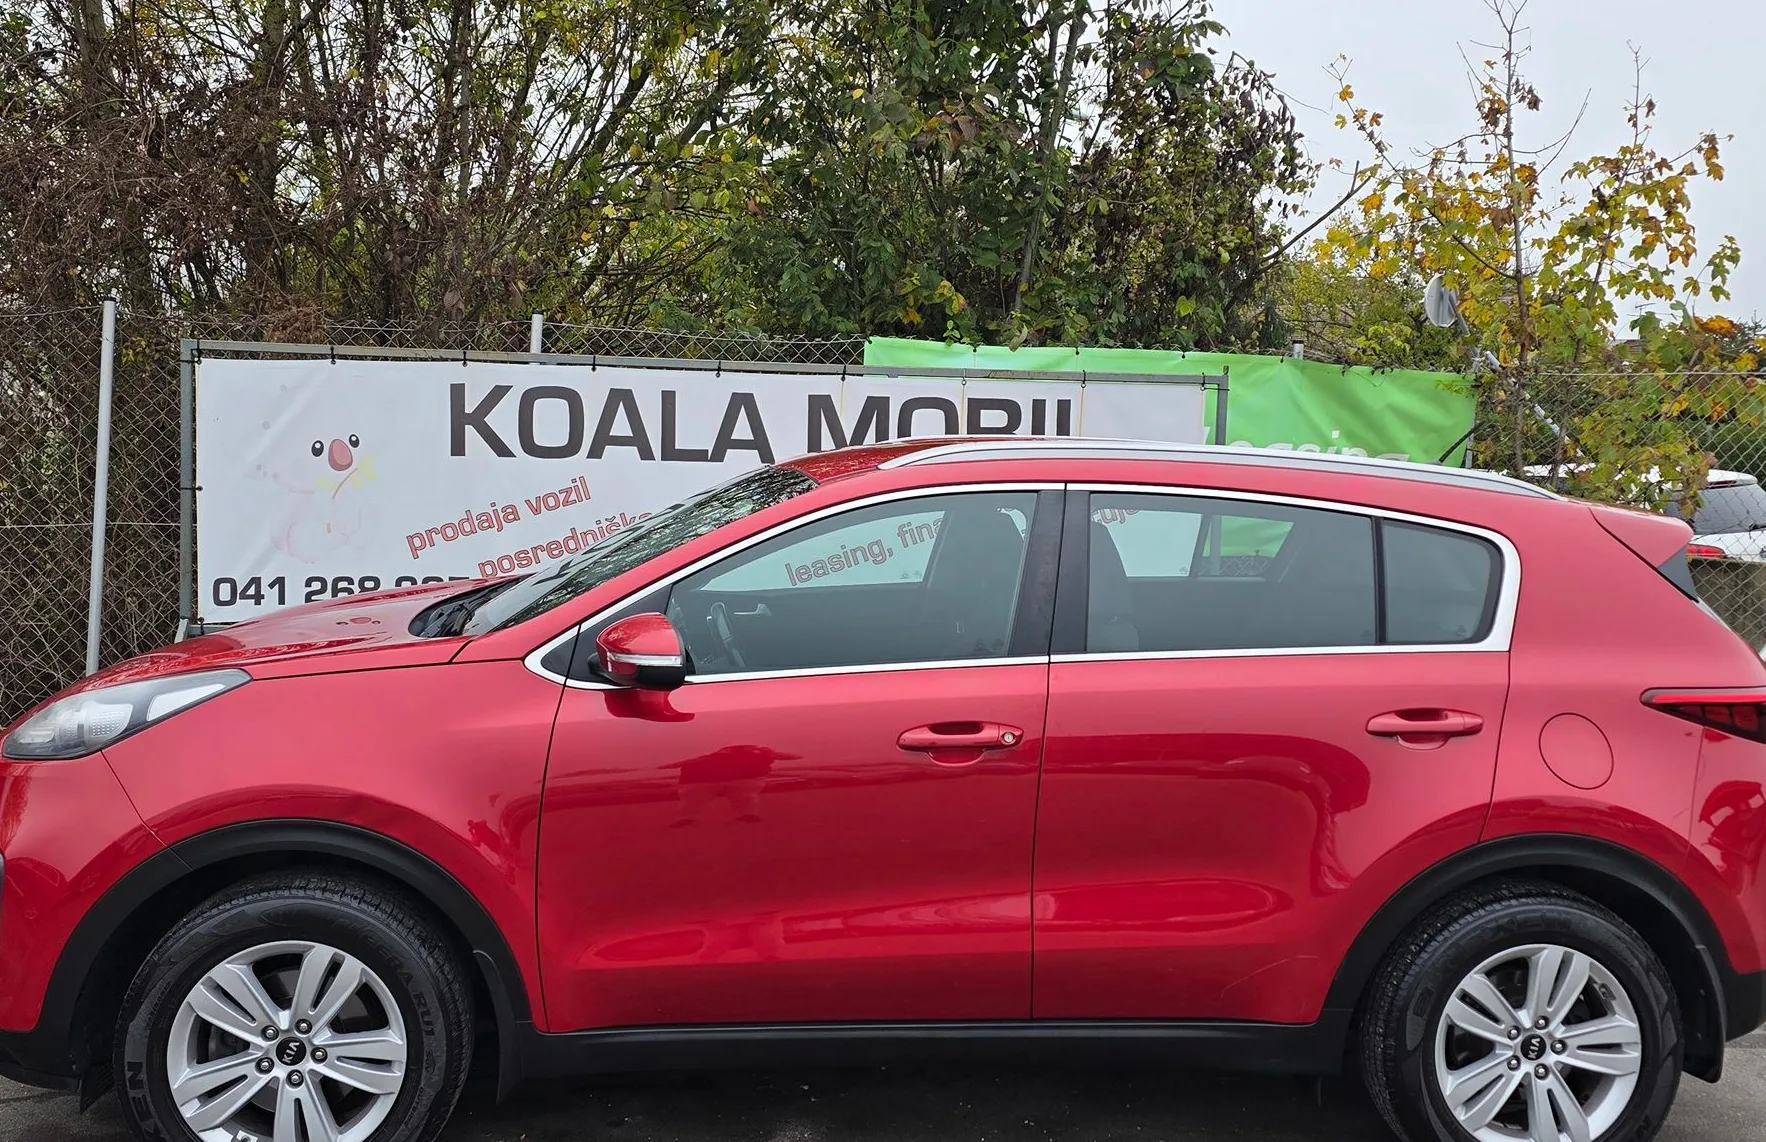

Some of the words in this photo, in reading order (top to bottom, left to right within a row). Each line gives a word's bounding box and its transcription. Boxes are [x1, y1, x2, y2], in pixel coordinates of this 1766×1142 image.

[449, 382, 775, 464] KOALA
[406, 501, 521, 560] prodaja
[525, 476, 592, 516] vozil
[478, 511, 653, 578] posrednišk
[785, 538, 894, 587] leasing,
[212, 576, 286, 607] 041
[282, 1042, 300, 1064] KIA
[1527, 1037, 1541, 1059] KIA
